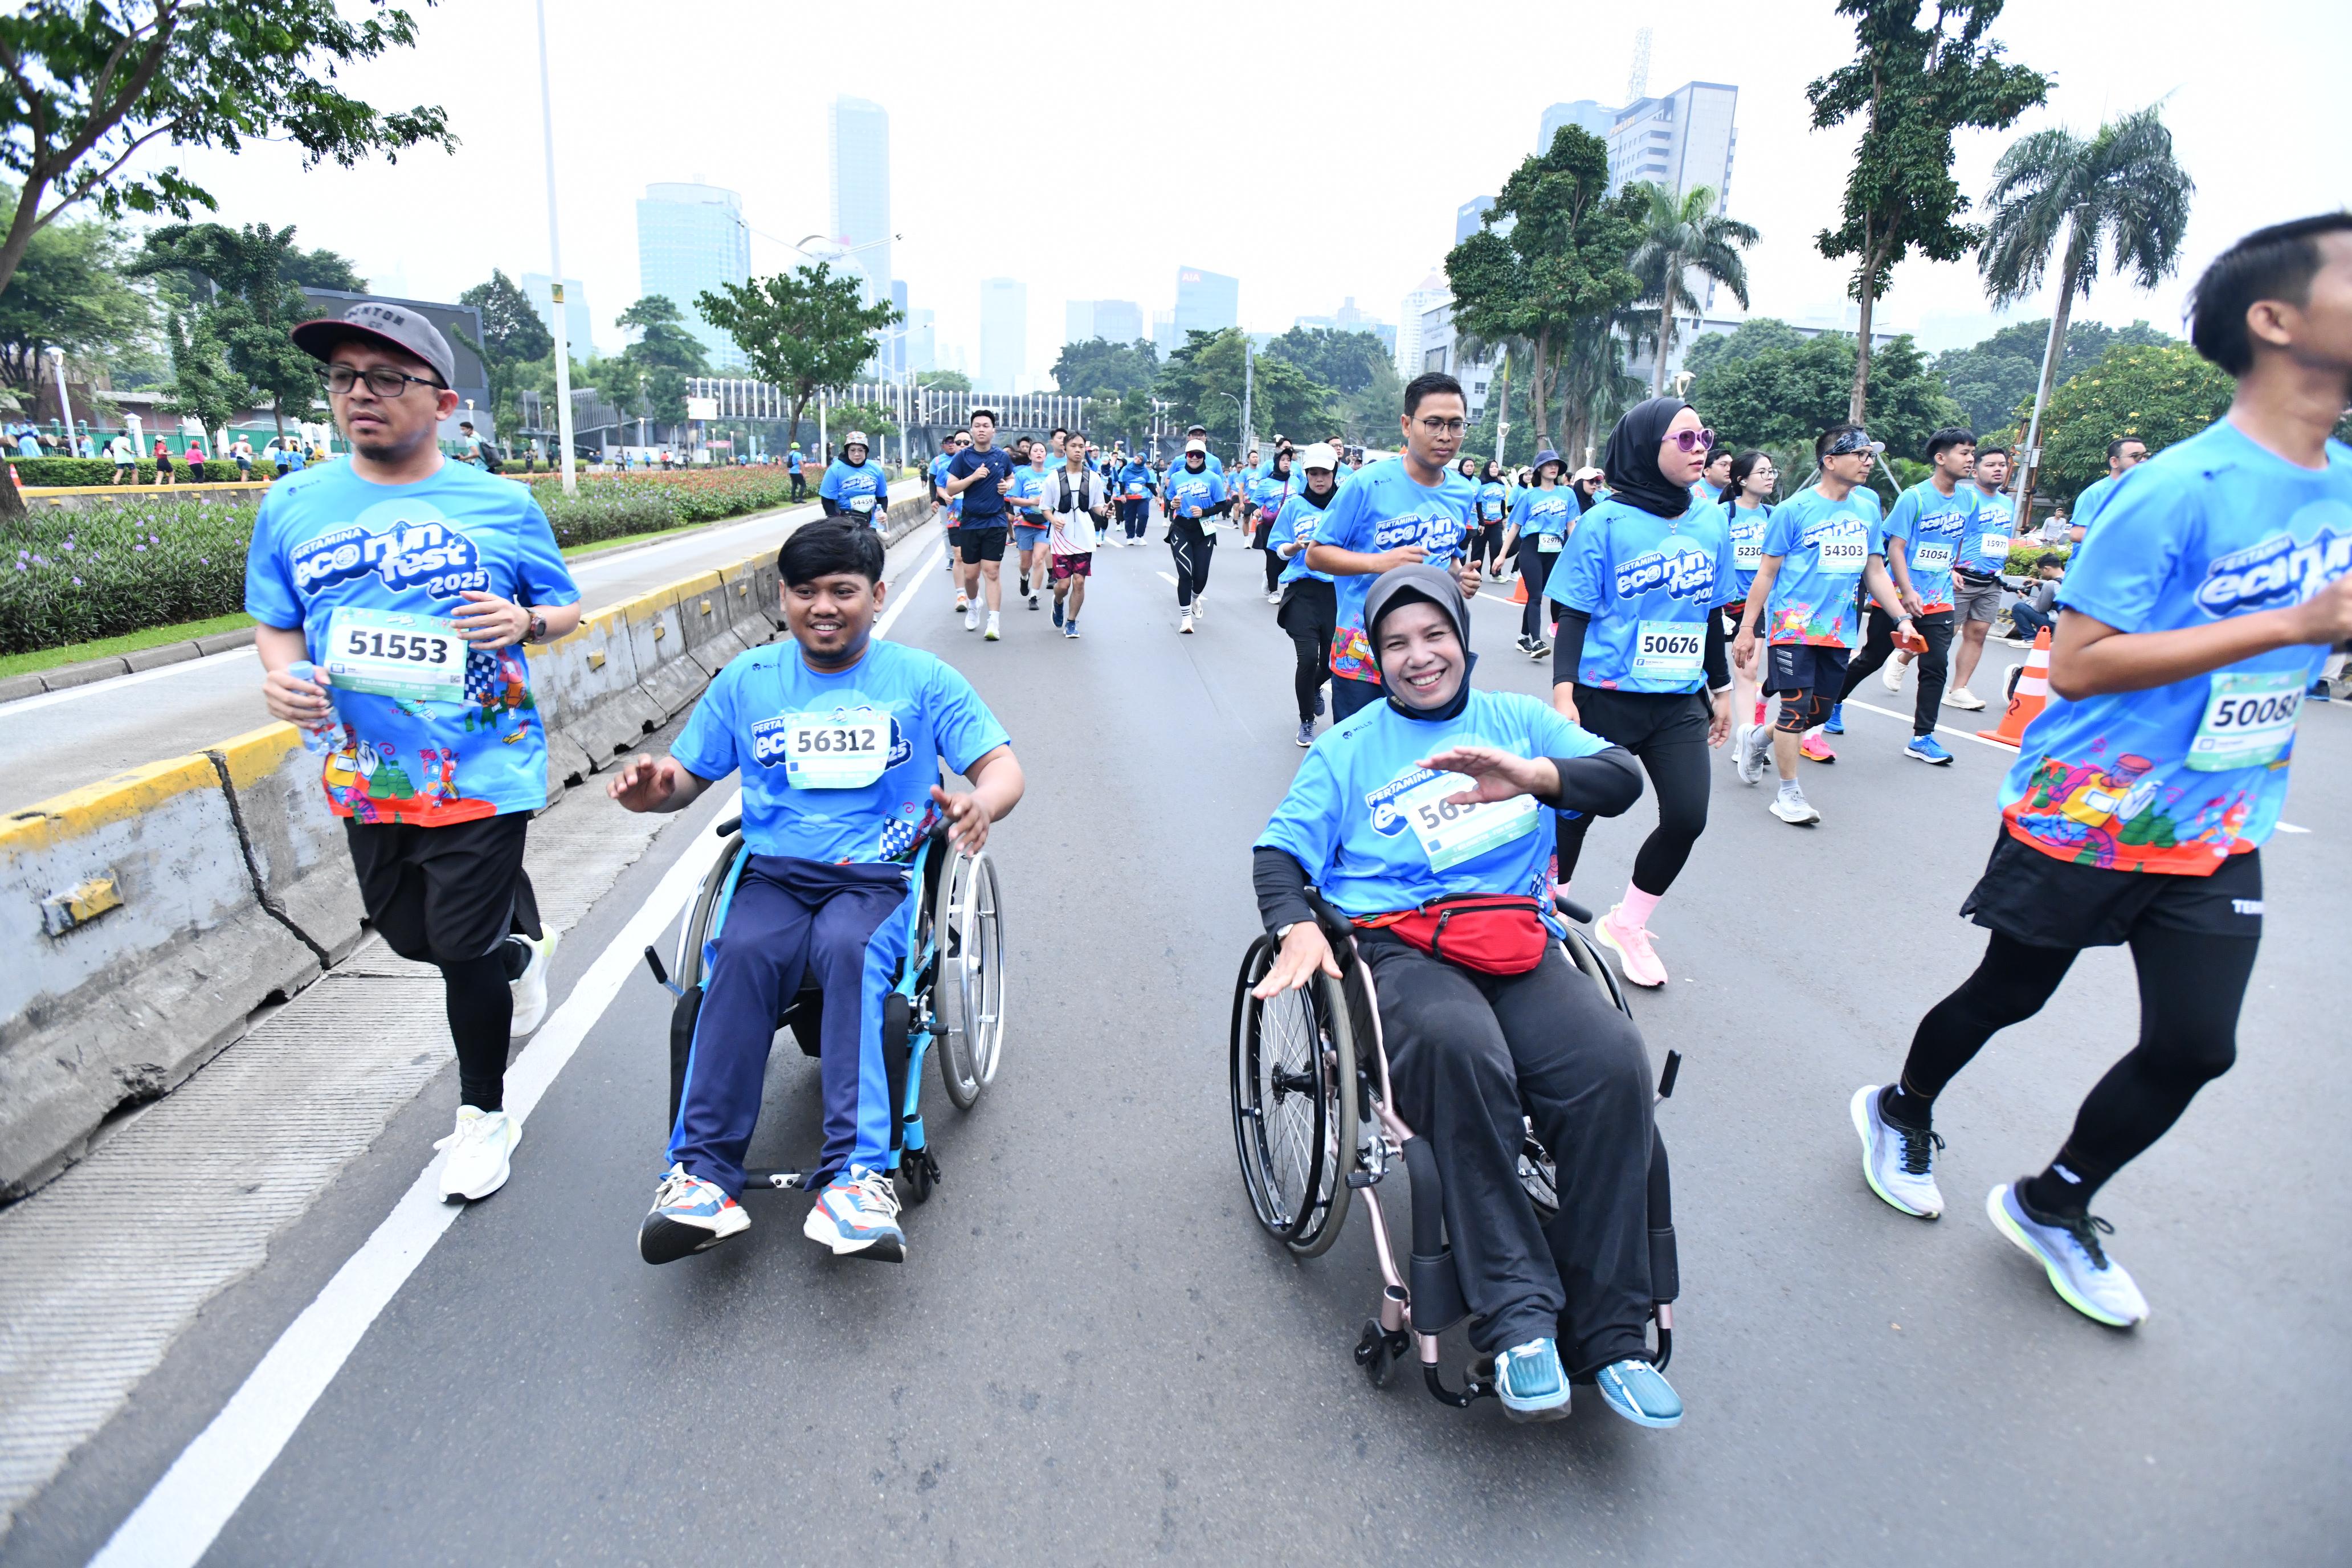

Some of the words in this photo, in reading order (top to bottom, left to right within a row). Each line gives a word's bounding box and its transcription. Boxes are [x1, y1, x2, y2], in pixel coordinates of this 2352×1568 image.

[1182, 273, 1200, 282] AIA
[1375, 525, 1416, 545] eco
[1416, 517, 1451, 537] run
[1378, 515, 1418, 529] PERTAMINA
[290, 527, 362, 560] PERTAMINA
[1420, 529, 1459, 551] fest
[1738, 547, 1762, 556] 5230
[1824, 545, 1863, 556] 54303
[296, 544, 361, 588] eco
[364, 523, 443, 563] run
[378, 537, 467, 582] fest
[1616, 554, 1661, 575] PERTAMINA
[1920, 549, 1948, 559] 51054
[430, 570, 485, 594] 2025
[1617, 565, 1661, 593] eco
[1663, 552, 1705, 579] run
[1669, 562, 1713, 593] fest
[348, 630, 447, 664] 51553
[1644, 636, 1698, 654] 50676
[1353, 721, 1372, 732] MILLS
[756, 732, 785, 758] ec
[798, 729, 875, 753] 56312
[1368, 769, 1435, 806] PERTAMINA
